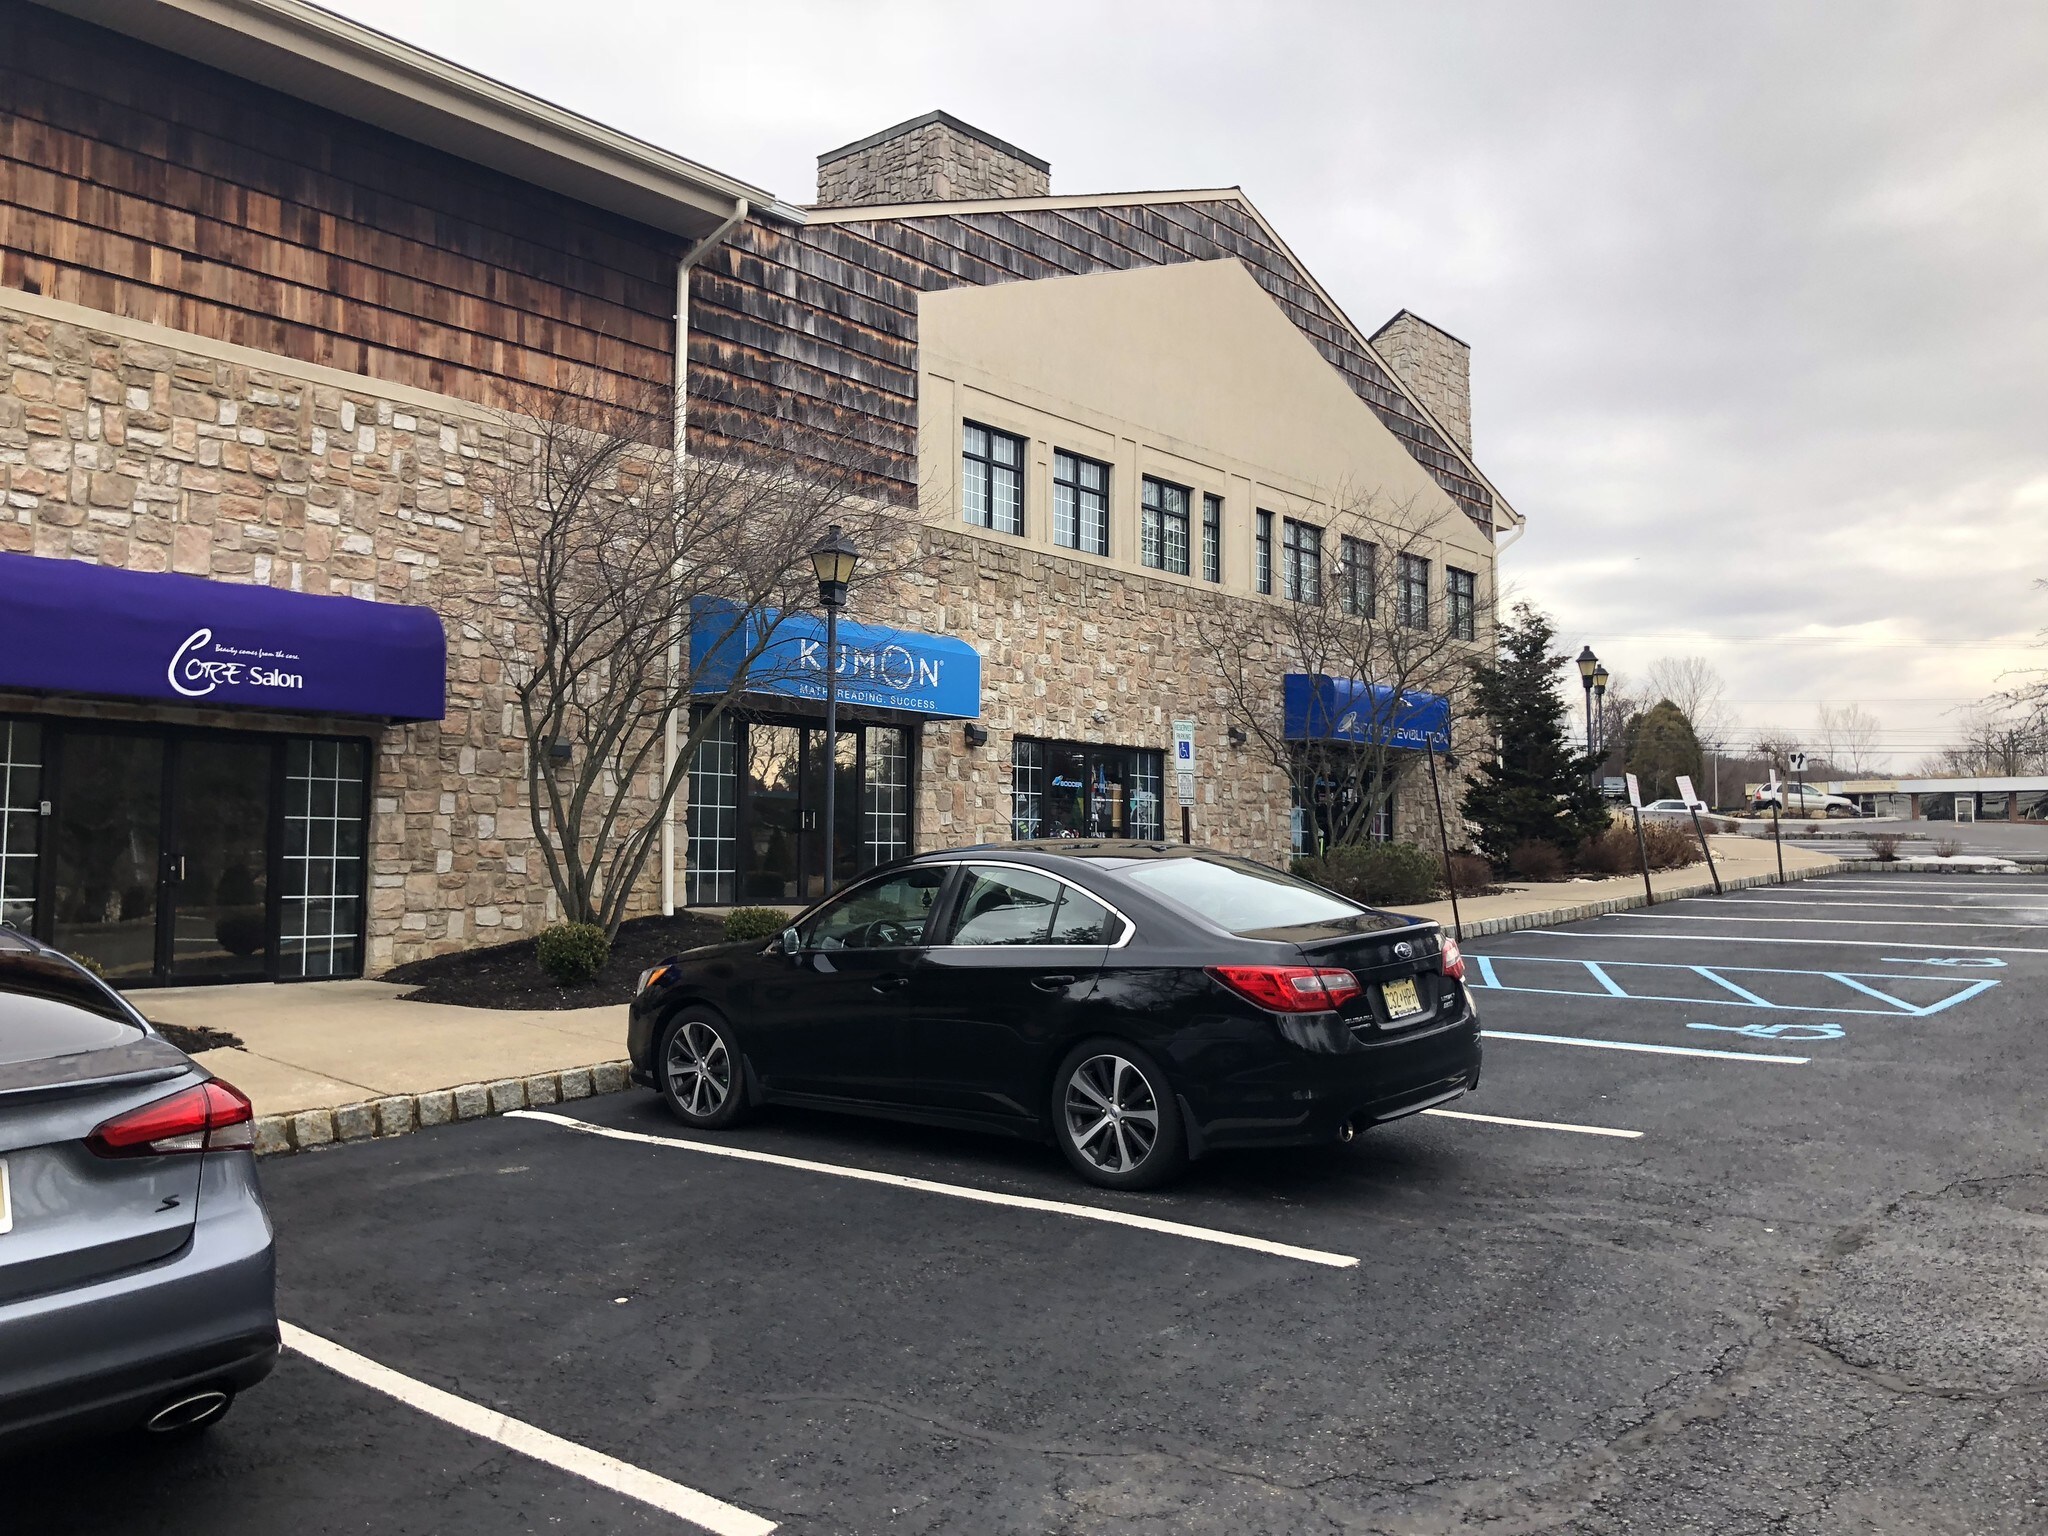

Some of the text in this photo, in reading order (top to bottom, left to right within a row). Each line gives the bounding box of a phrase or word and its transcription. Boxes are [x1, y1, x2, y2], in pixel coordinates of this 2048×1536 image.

[215, 643, 238, 656] Beauty
[259, 648, 275, 658] from
[275, 650, 285, 658] the
[249, 667, 303, 688] Salon
[837, 689, 887, 704] READING.
[890, 695, 938, 710] SUCCESS.
